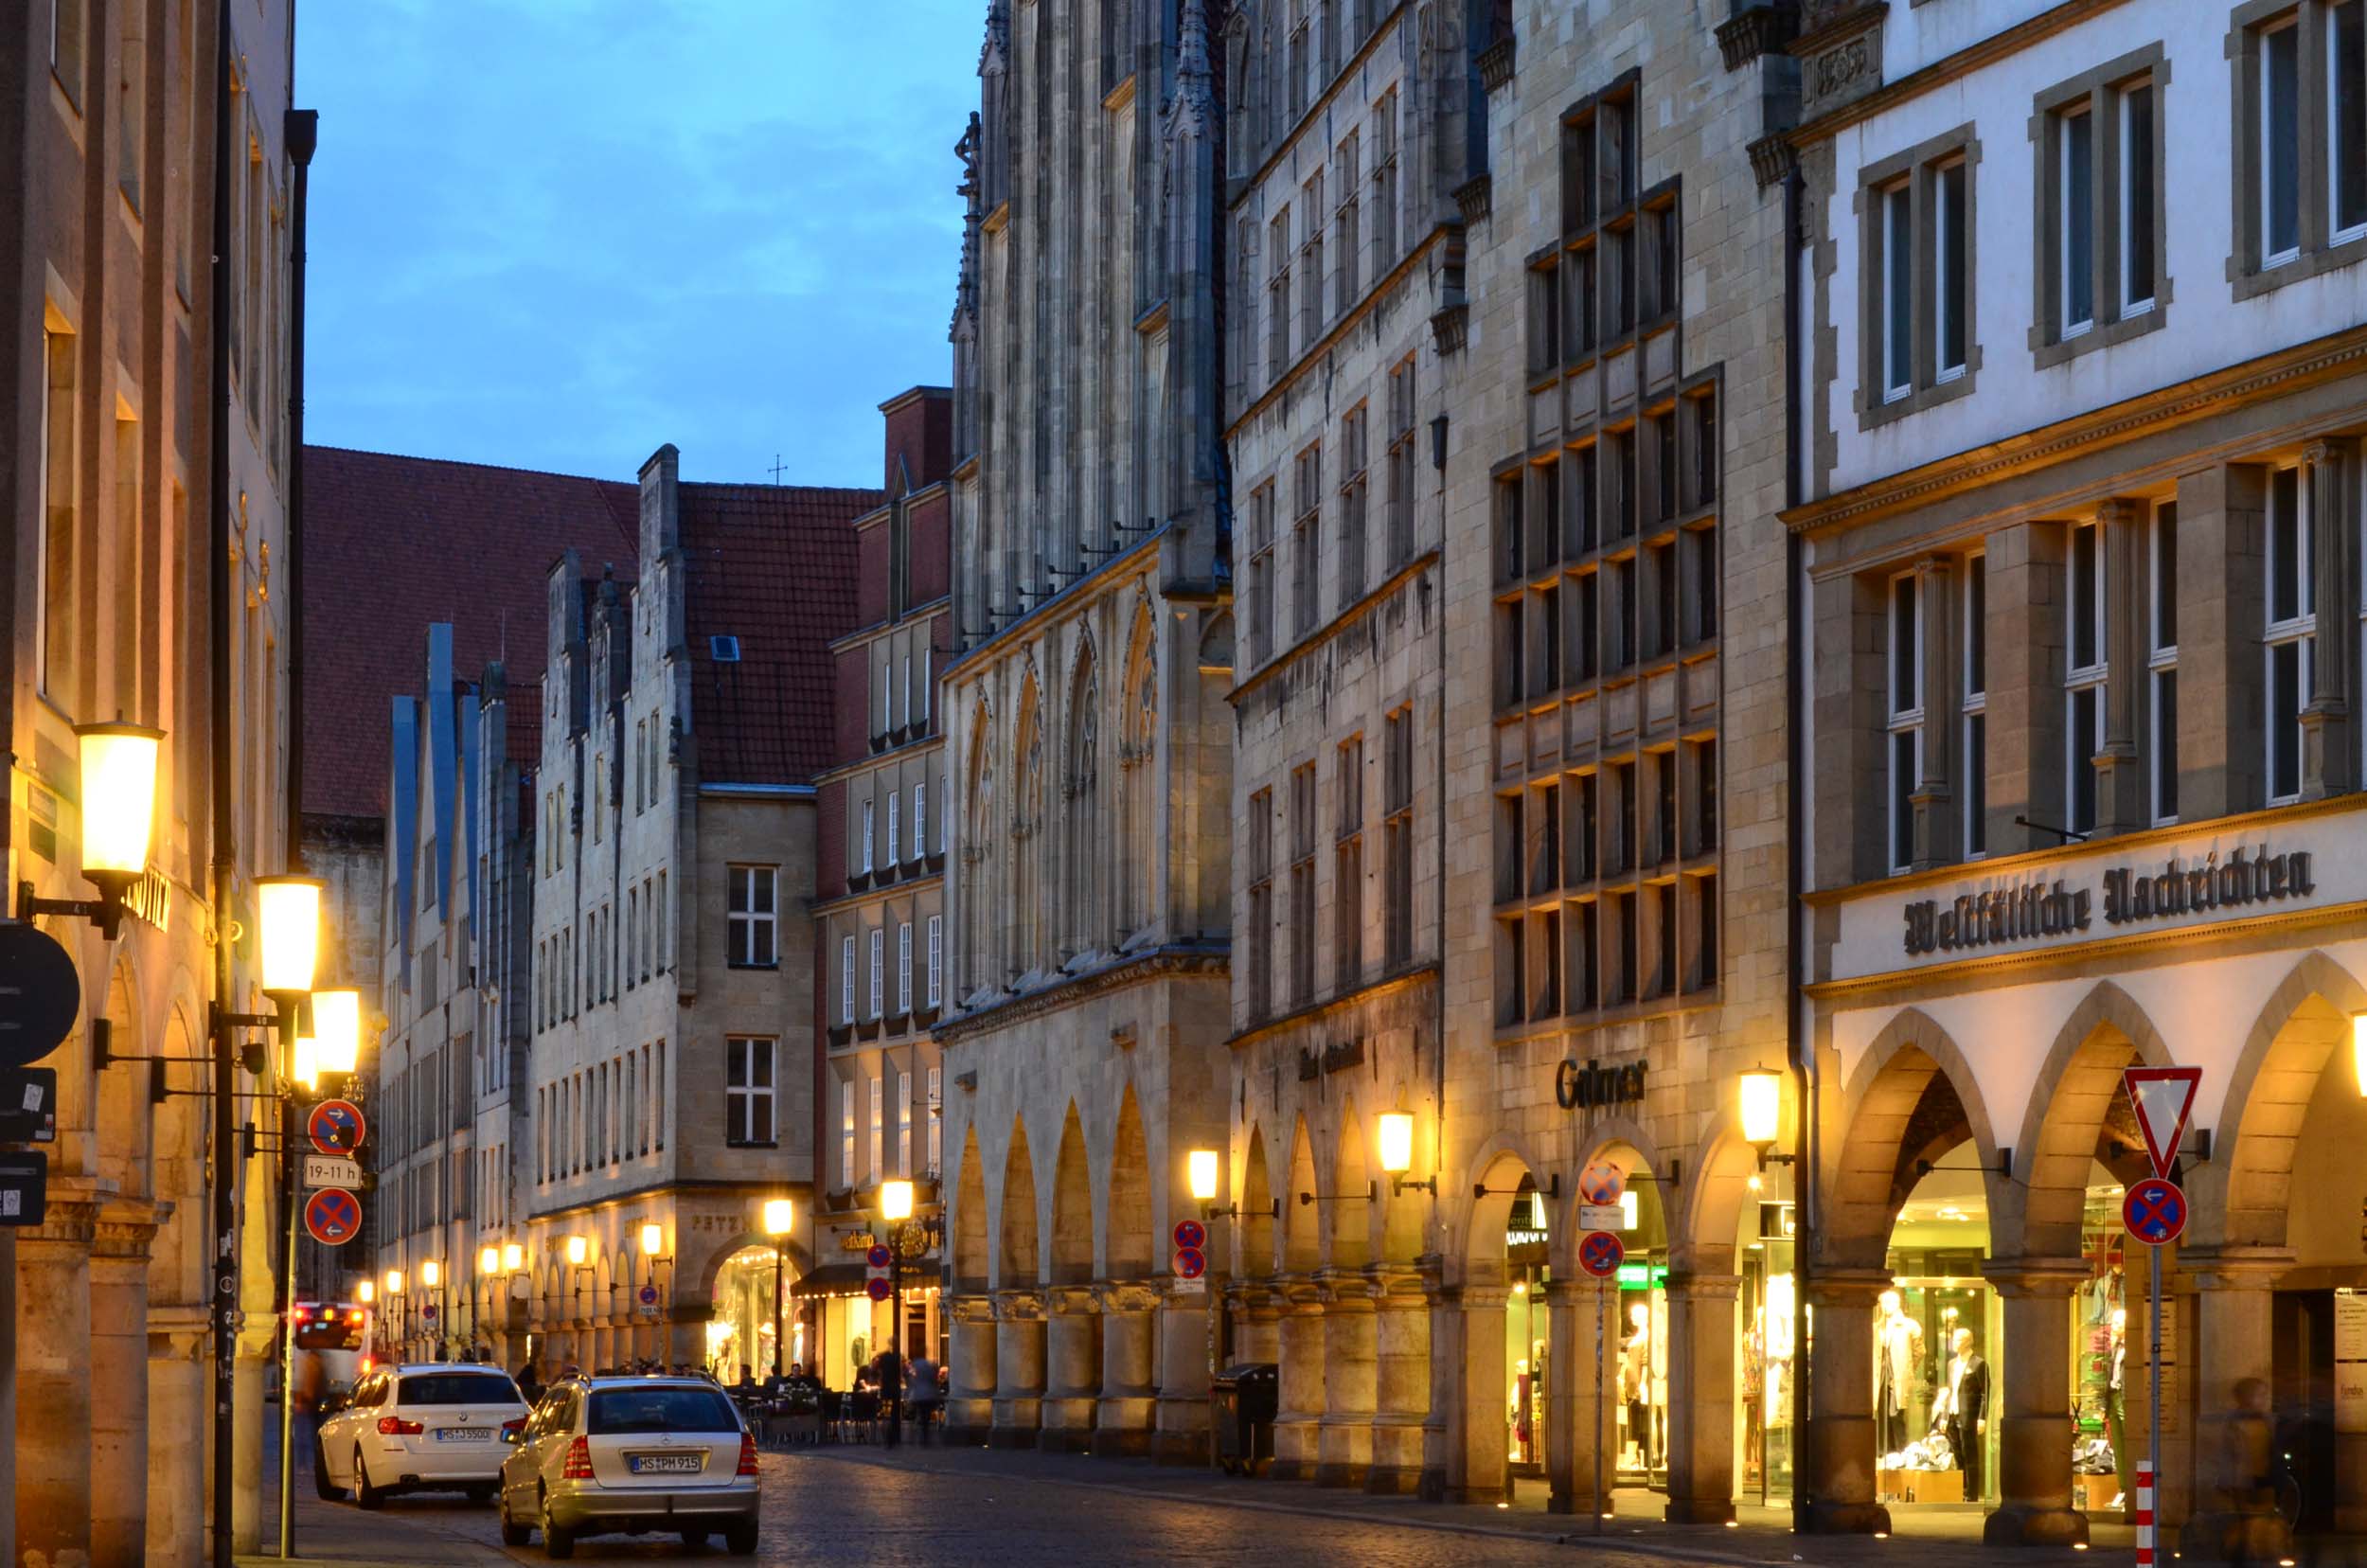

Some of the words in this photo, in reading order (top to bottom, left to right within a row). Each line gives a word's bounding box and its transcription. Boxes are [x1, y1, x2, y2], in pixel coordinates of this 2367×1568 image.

[2104, 843, 2316, 924] Nachrichten
[310, 1166, 341, 1179] 19-11
[347, 1166, 356, 1180] h
[677, 1457, 698, 1469] 915
